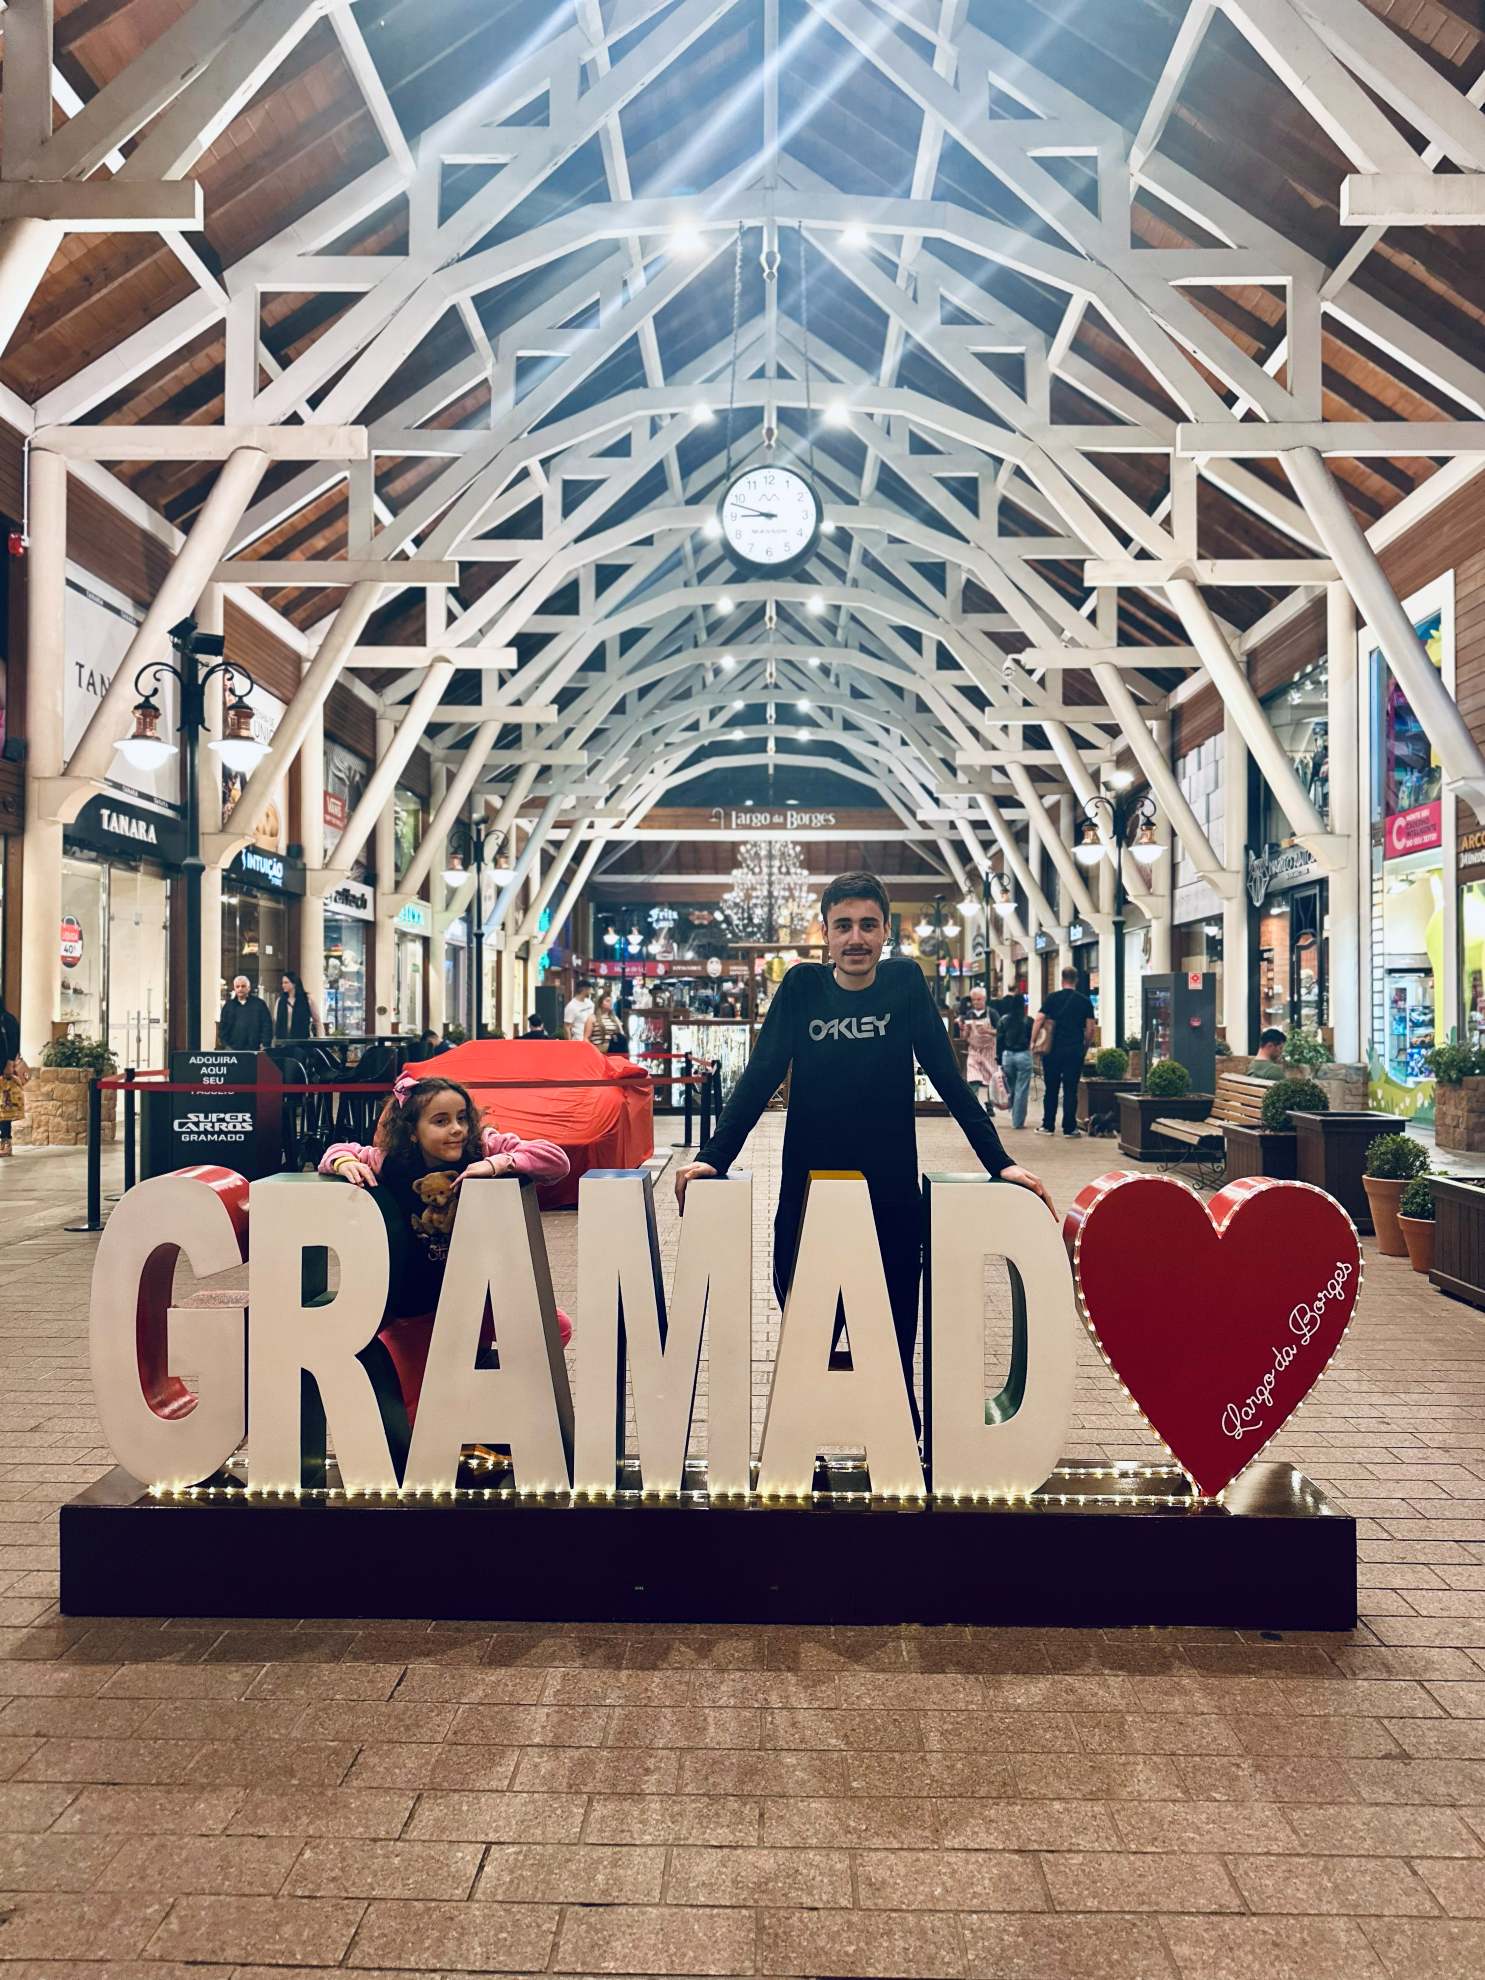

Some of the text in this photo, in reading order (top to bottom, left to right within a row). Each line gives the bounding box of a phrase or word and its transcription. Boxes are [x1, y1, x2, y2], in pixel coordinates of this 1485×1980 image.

[747, 480, 757, 490] 11
[764, 475, 775, 485] 12
[735, 493, 745, 504] 10
[797, 492, 804, 502] 2
[730, 512, 737, 521] 9
[802, 510, 809, 520] 3
[735, 529, 742, 539] 8
[796, 528, 803, 537] 4
[747, 543, 754, 552] 7
[766, 547, 773, 557] 6
[784, 542, 791, 552] 5
[731, 810, 836, 829] Largo da Borges
[100, 808, 158, 845] TANARA
[808, 1012, 891, 1042] OAKLEY
[189, 1056, 238, 1064] ADQUIRA
[200, 1066, 227, 1075] AQUI
[202, 1076, 224, 1085] SEU
[187, 1112, 253, 1122] SUPER
[173, 1119, 254, 1132] CARROS
[181, 1133, 245, 1142] GRAMADO
[1221, 1261, 1352, 1440] Largo da Borges
